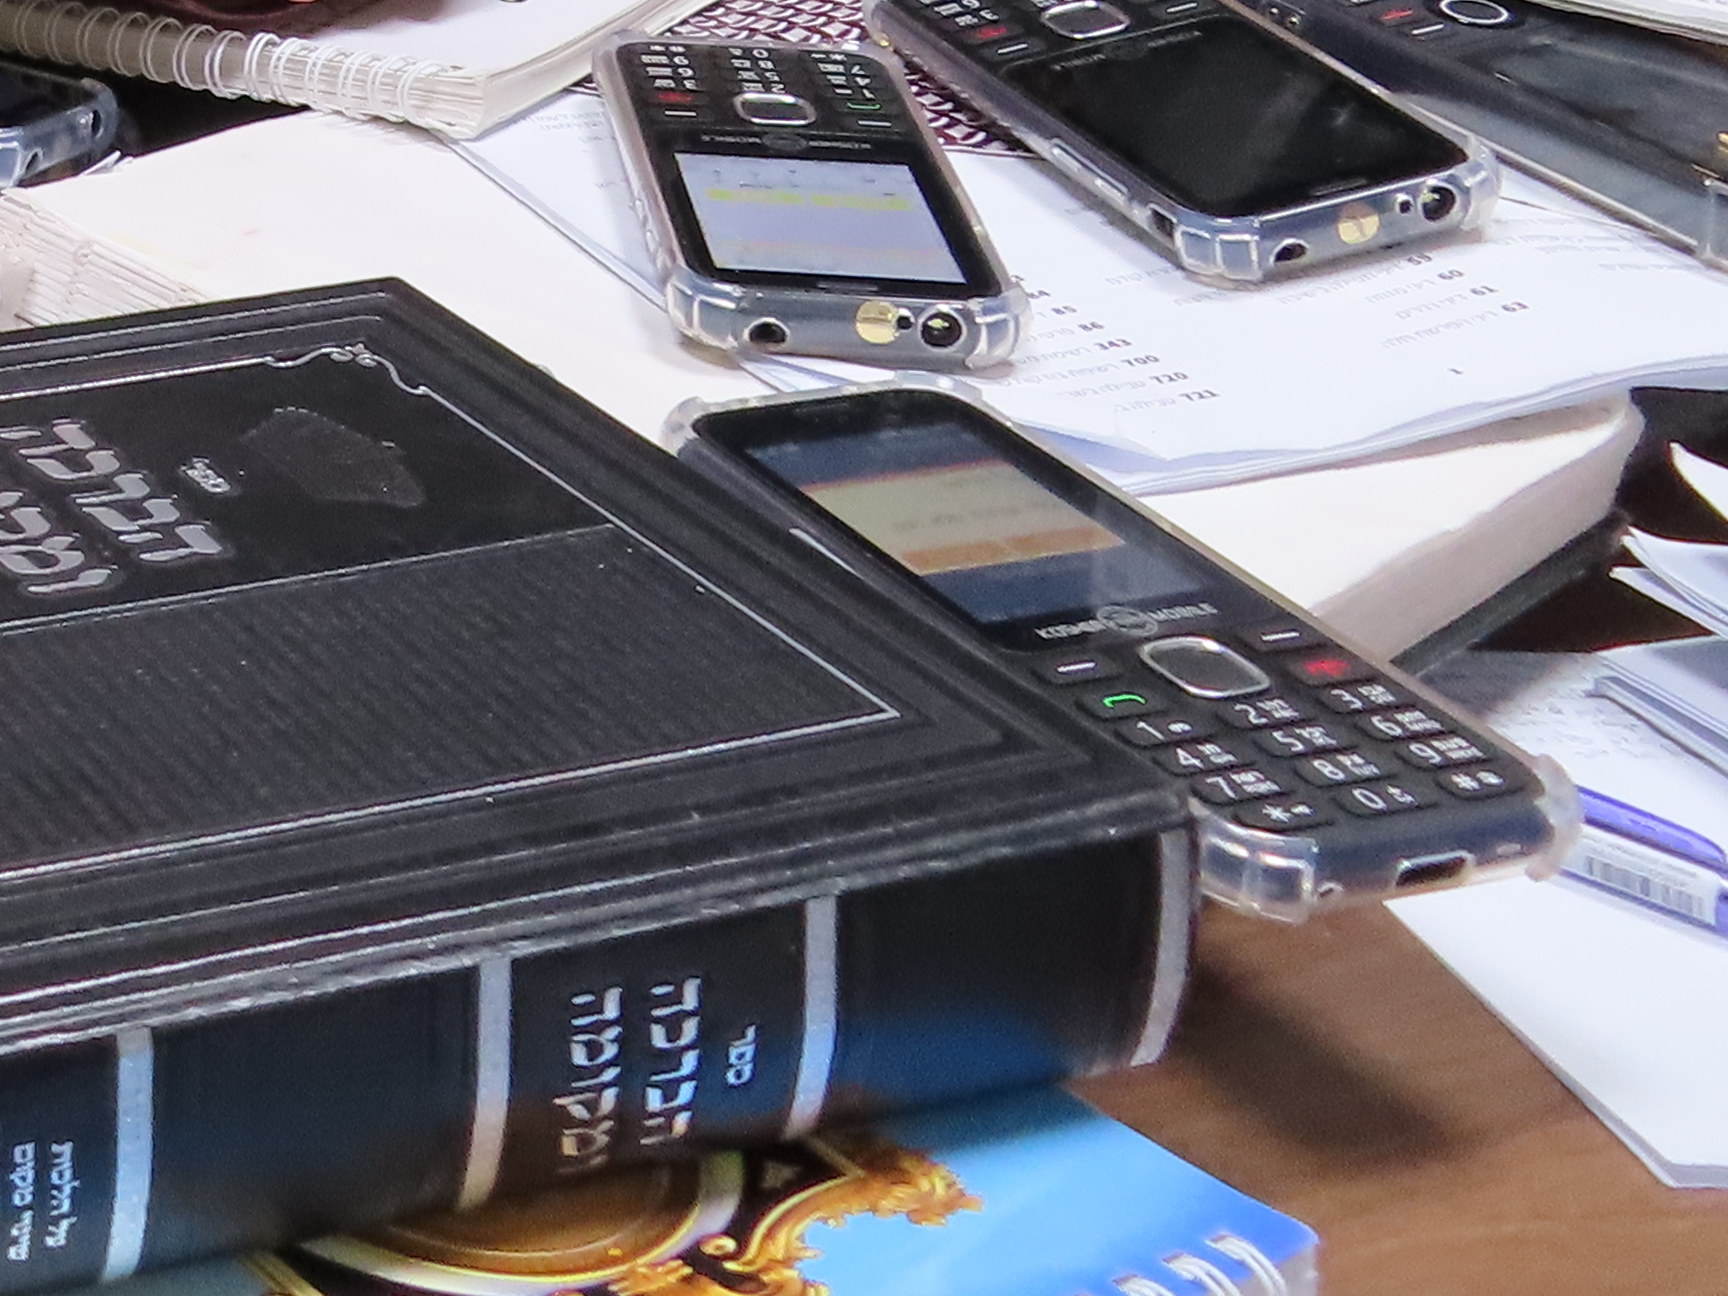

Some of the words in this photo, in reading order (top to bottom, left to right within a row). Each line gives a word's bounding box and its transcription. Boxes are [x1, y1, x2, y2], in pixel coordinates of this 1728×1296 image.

[1121, 355, 1160, 367] 700
[1179, 389, 1220, 403] 721
[1330, 688, 1365, 711] 3
[1233, 702, 1269, 725] 2
[1136, 720, 1165, 742] 1
[1370, 715, 1404, 738] 6
[1271, 730, 1307, 754] 5
[1408, 742, 1446, 766] 9
[1175, 747, 1200, 769] 4
[1311, 759, 1347, 781] 8
[1207, 774, 1236, 799] 7
[1352, 787, 1388, 812] 0
[641, 975, 702, 1148] הברכה
[726, 1023, 757, 1087] ספר
[555, 986, 624, 1173] ומקומה
[11, 1143, 37, 1209] מקום
[50, 1141, 79, 1216] הלכות
[45, 1214, 77, 1251] על
